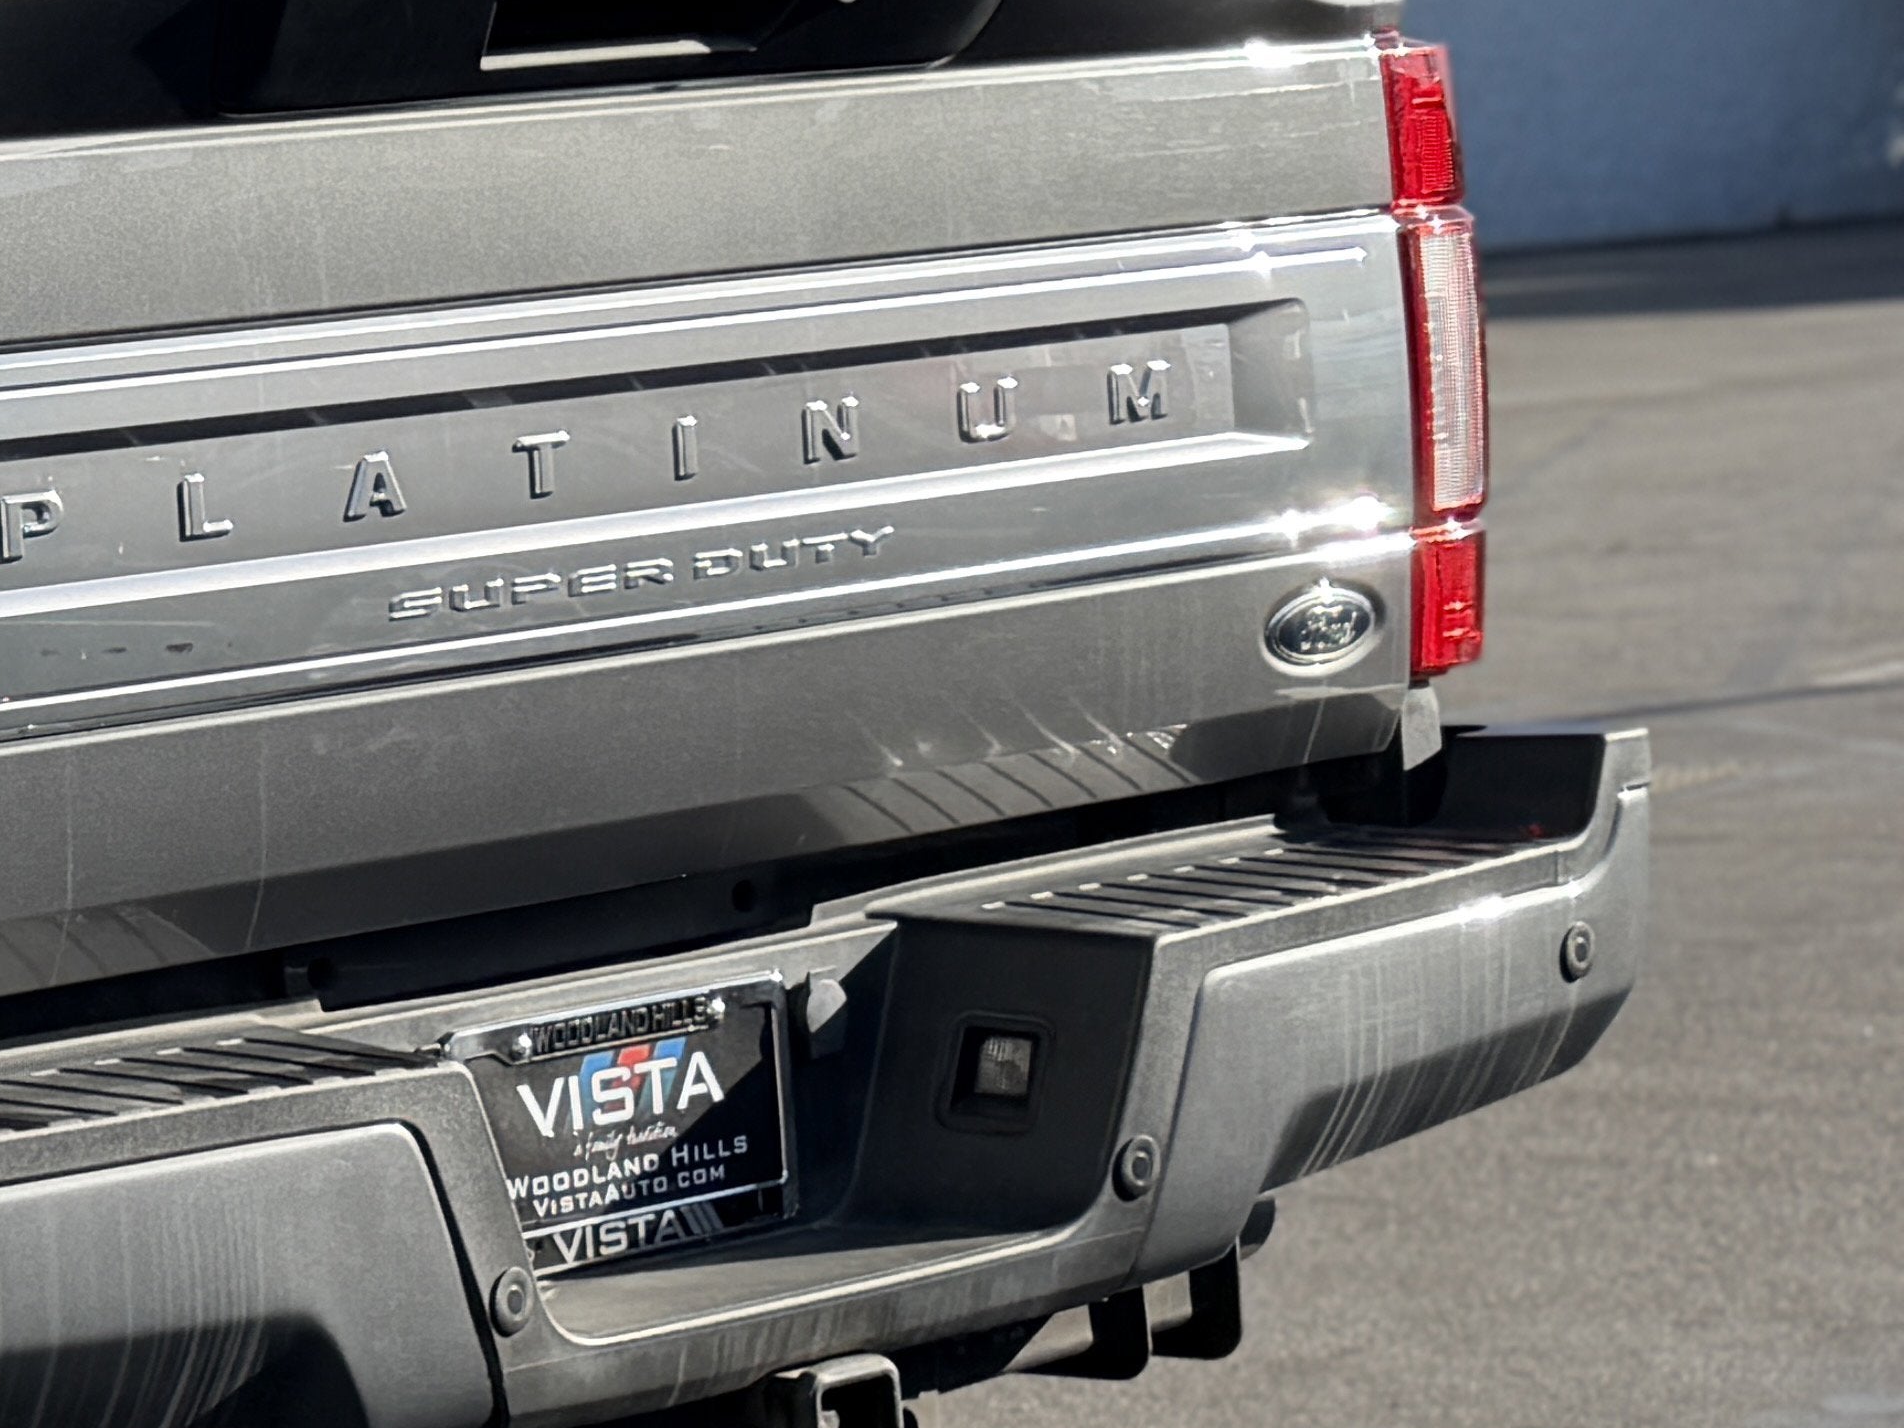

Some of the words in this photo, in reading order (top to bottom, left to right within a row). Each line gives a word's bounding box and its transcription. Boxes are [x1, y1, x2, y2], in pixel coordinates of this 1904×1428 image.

[390, 558, 674, 622] SUPER
[694, 525, 896, 580] DUTY
[532, 1006, 648, 1053] WOODLAND
[651, 996, 709, 1032] HILLS
[516, 1051, 725, 1138] VISTA
[506, 1153, 660, 1201] WOODLAND
[671, 1135, 748, 1167] HILLS
[553, 1208, 686, 1264] VISTA
